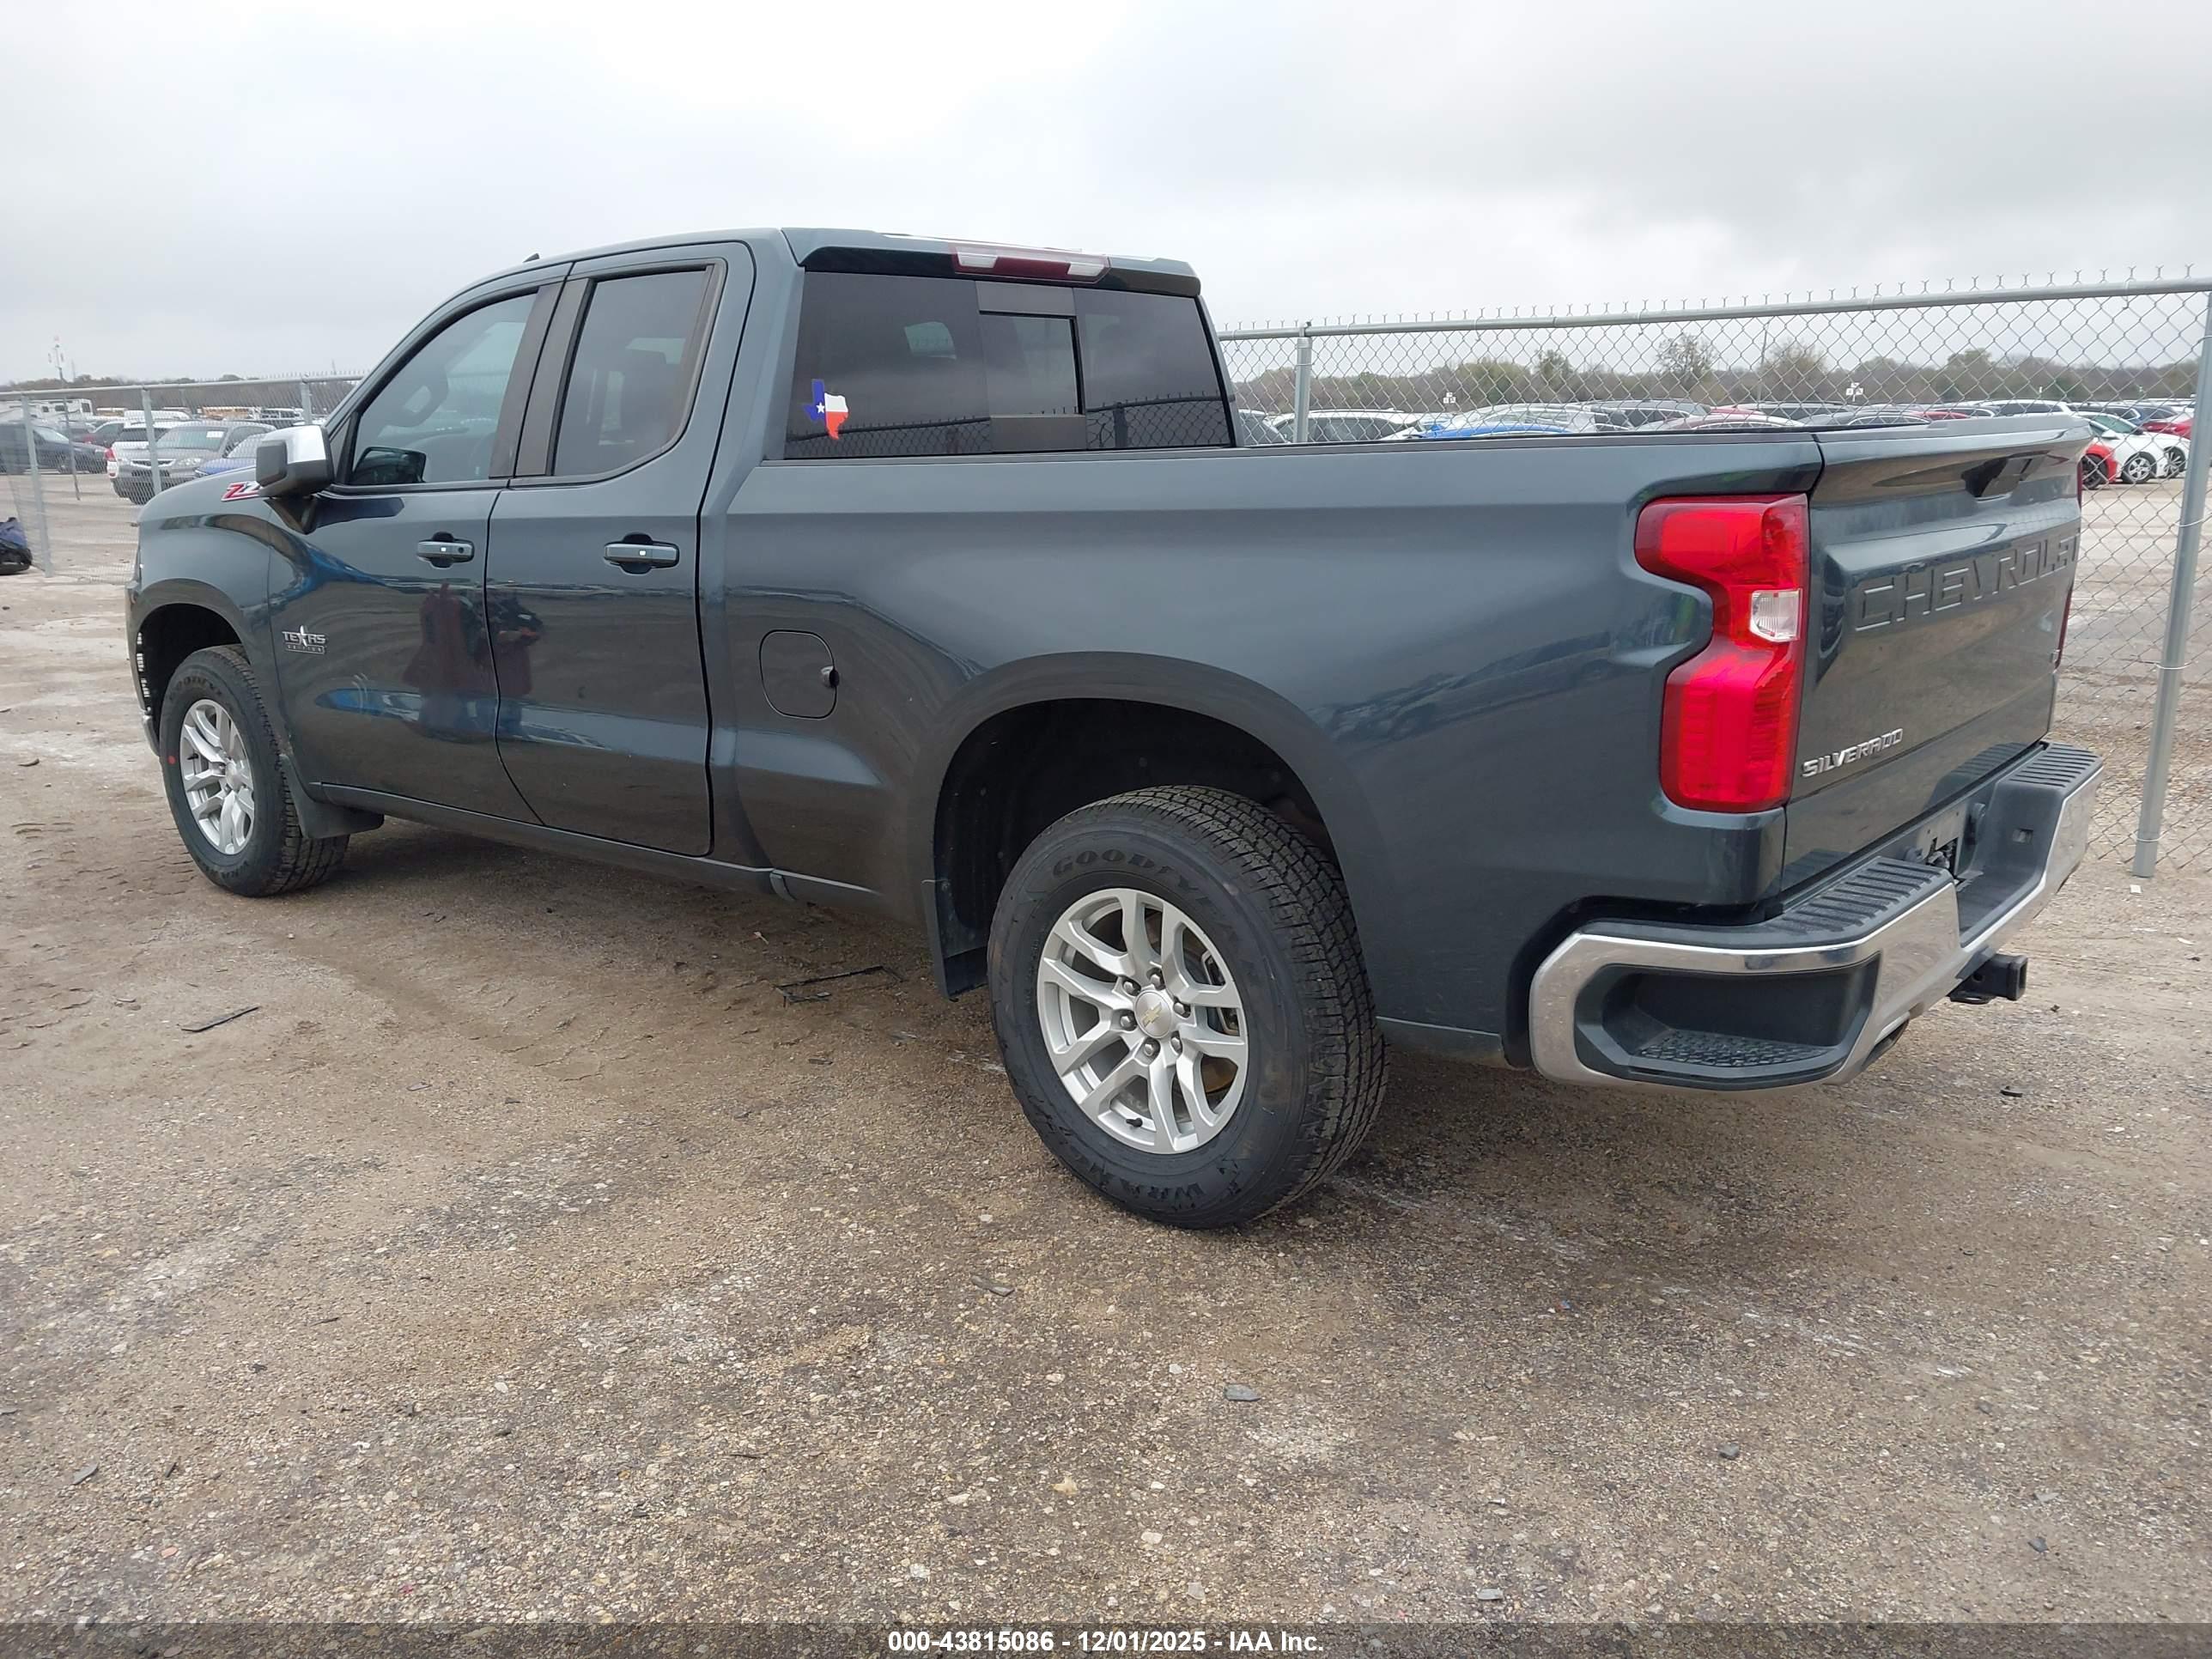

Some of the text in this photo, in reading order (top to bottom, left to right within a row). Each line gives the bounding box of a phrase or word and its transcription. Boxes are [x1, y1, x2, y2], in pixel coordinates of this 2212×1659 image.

[221, 481, 261, 501] Z7
[1855, 532, 2080, 632] CHEVROLET
[1801, 728, 1904, 778] SILVERADO
